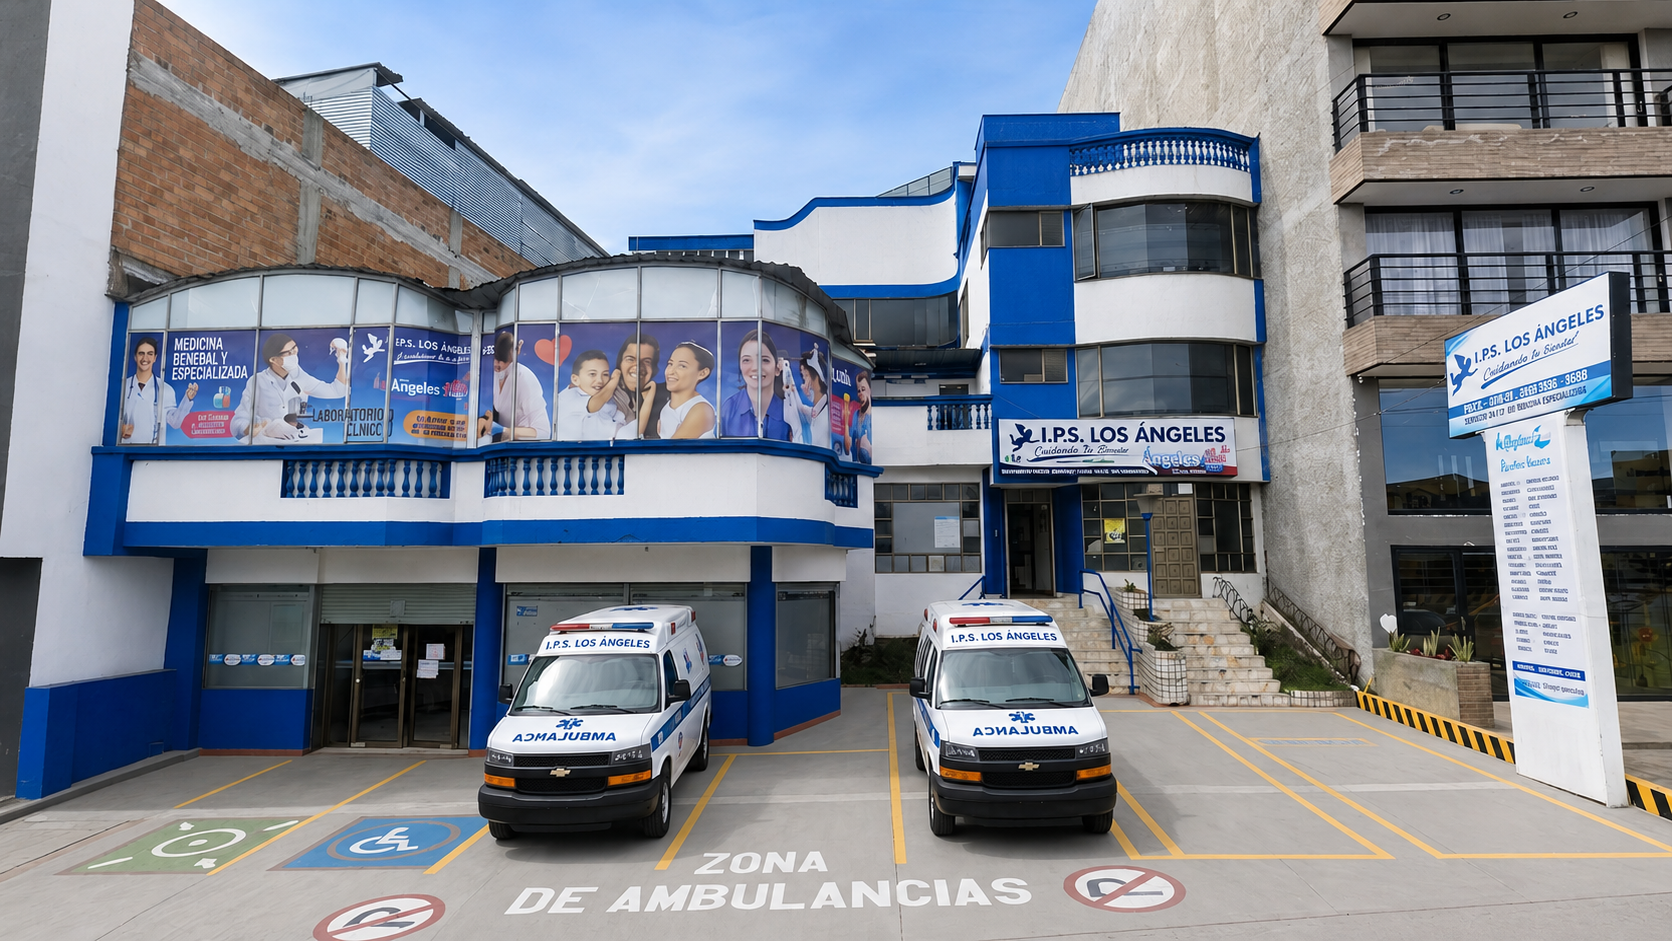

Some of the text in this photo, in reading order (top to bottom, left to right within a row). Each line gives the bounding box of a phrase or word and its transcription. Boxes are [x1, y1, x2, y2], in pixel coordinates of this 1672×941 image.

[1474, 304, 1605, 364] I.P.S. LOS ÁNGELES
[174, 337, 223, 351] MEDICINA
[418, 339, 438, 351] LOS
[221, 351, 228, 365] Y
[172, 365, 248, 380] ESPECIALIZADA
[1041, 421, 1226, 443] I.P.S. LOS ÁNGELES
[545, 635, 651, 650] I.P.S. LOS ÁNGELES
[951, 629, 1058, 643] I.P.S. LOS ÁNGELES
[694, 850, 828, 875] ZONA
[503, 877, 1033, 915] DE AMBULANCIAS
